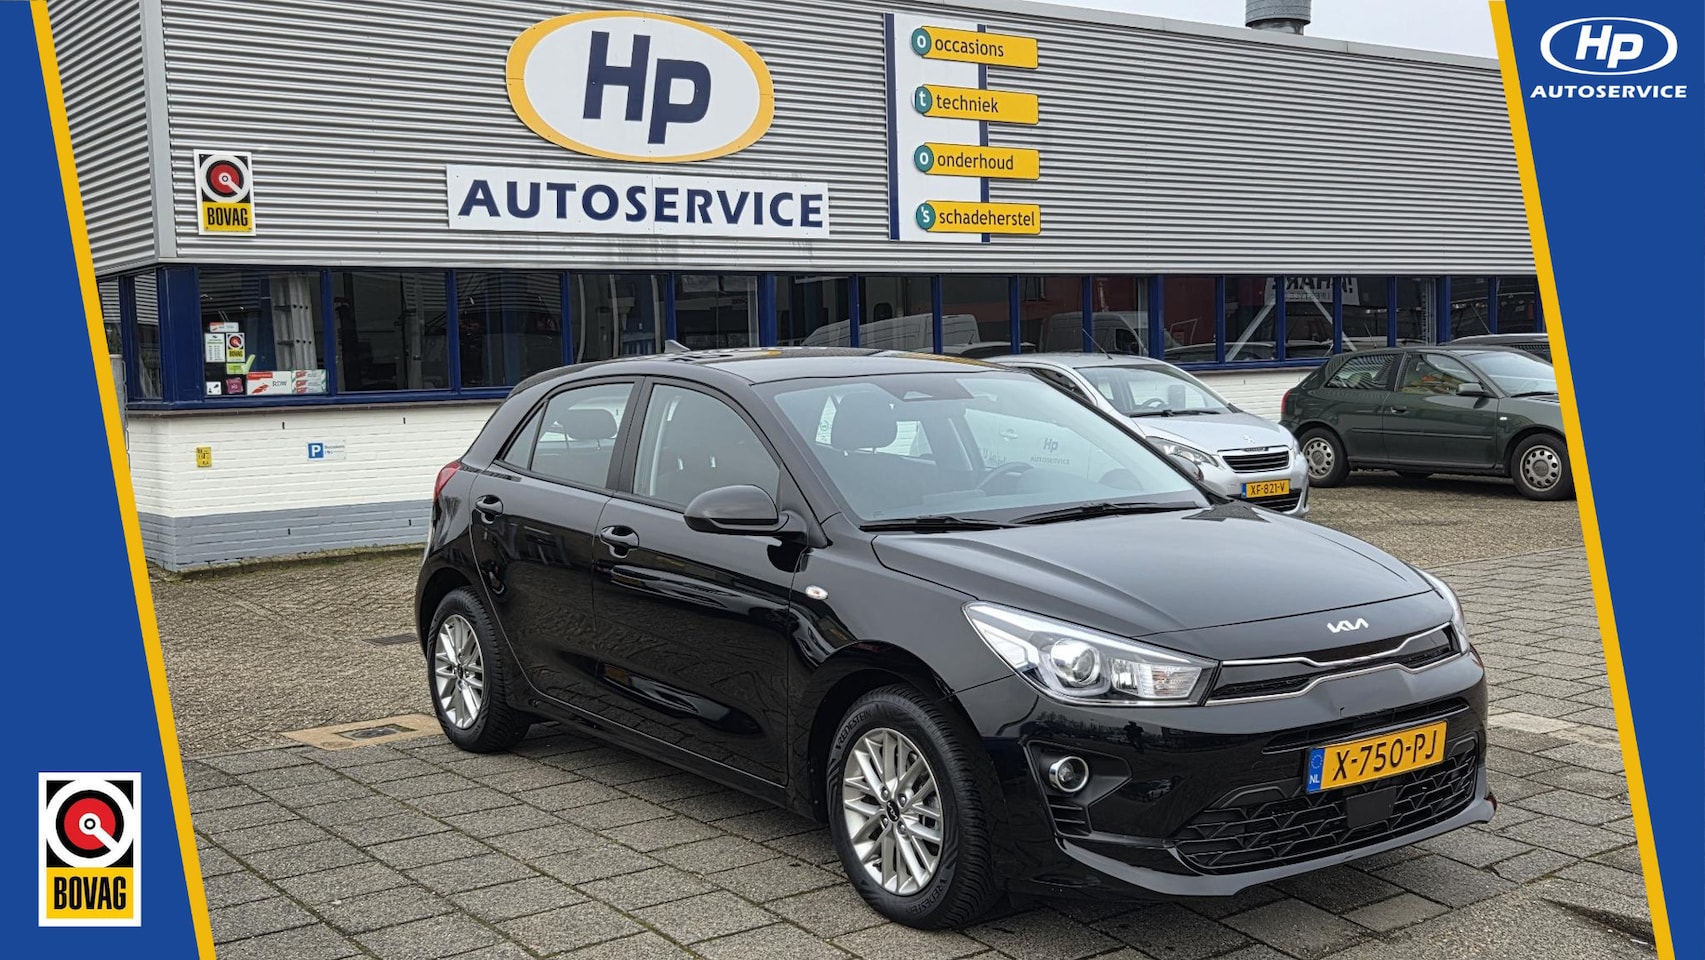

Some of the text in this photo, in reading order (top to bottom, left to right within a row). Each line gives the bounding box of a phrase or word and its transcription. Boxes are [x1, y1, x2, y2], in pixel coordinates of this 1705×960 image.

[935, 38, 1004, 57] occasions
[936, 94, 999, 113] techniek
[937, 152, 1014, 170] onderhoud
[458, 179, 823, 228] AUTOSERVICE
[207, 207, 248, 227] BOVAG
[939, 208, 1035, 226] schadeherstel
[311, 445, 321, 457] P
[1030, 456, 1070, 465] AUTOSERVICE
[1250, 482, 1285, 496] XF-821-V
[1332, 730, 1437, 781] X-750-PJ
[1309, 774, 1320, 784] NL
